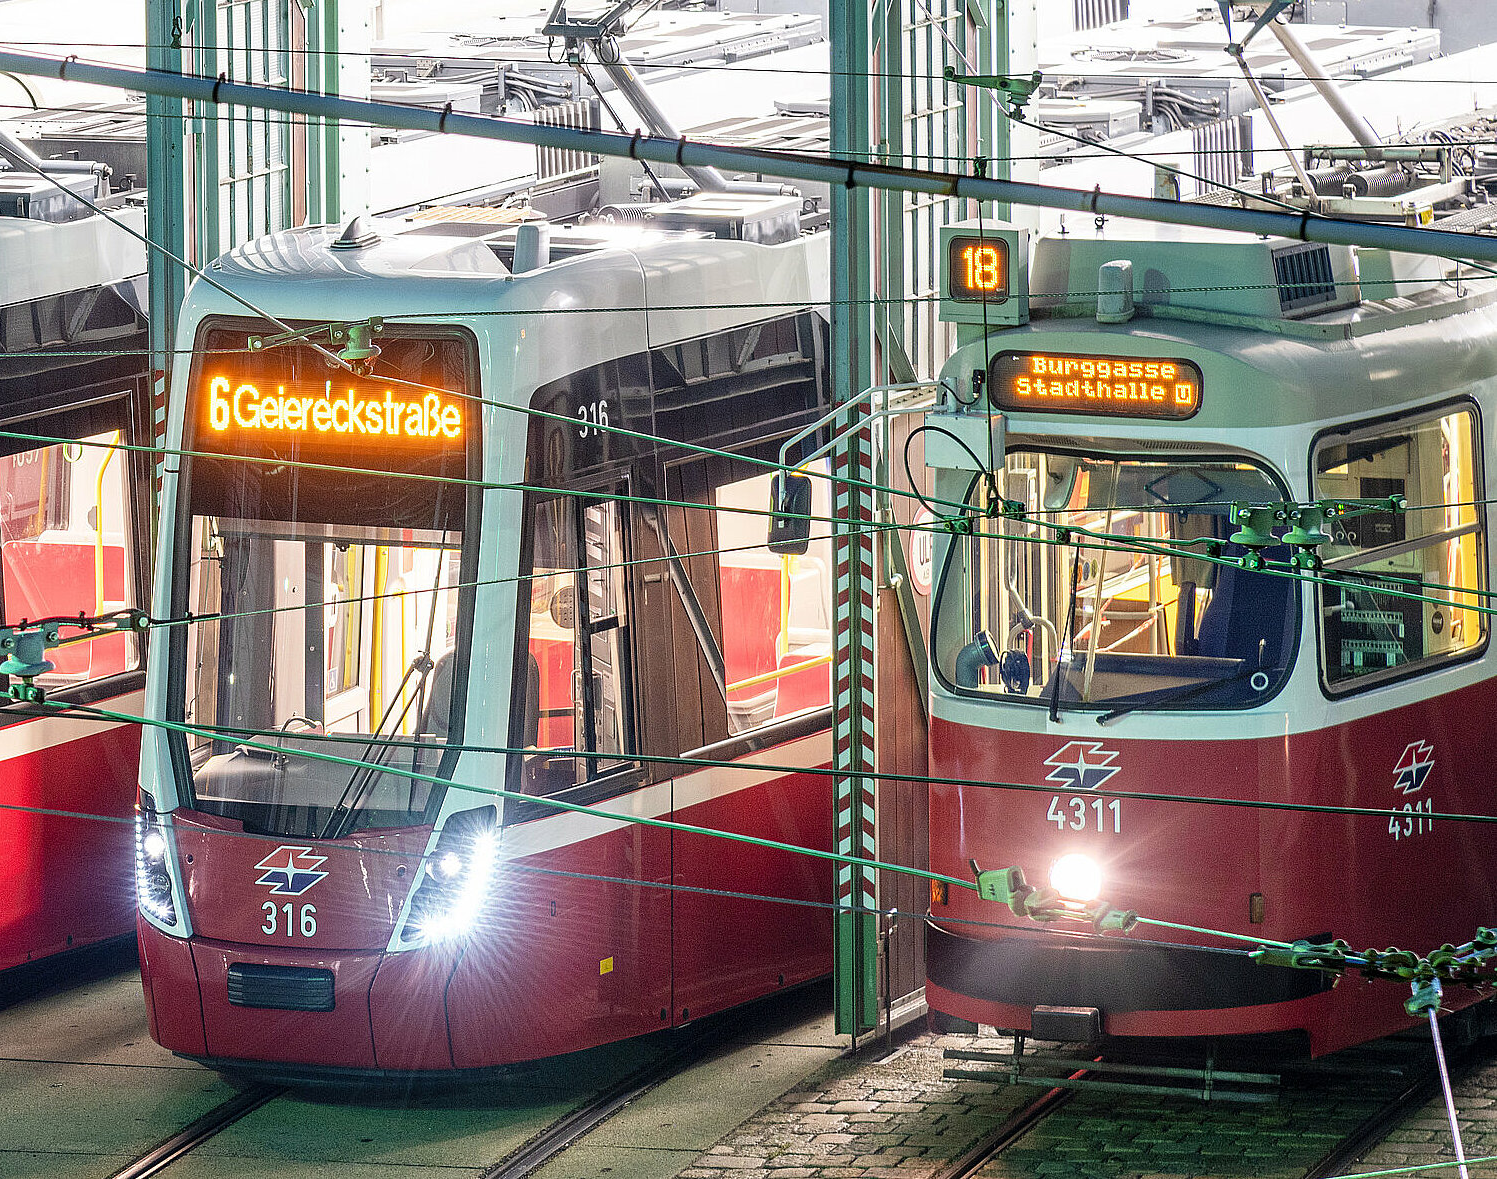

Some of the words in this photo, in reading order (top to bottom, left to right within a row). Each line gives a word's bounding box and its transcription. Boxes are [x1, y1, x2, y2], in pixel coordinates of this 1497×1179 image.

[963, 246, 998, 288] 18
[1032, 356, 1176, 380] Burggasse
[209, 376, 230, 431] 6
[232, 384, 462, 438] Geiereckstraße
[1016, 377, 1166, 401] Stadthalle
[577, 399, 609, 438] 316
[1046, 795, 1121, 833] 4311
[1388, 797, 1432, 841] 4311
[261, 901, 317, 938] 316
